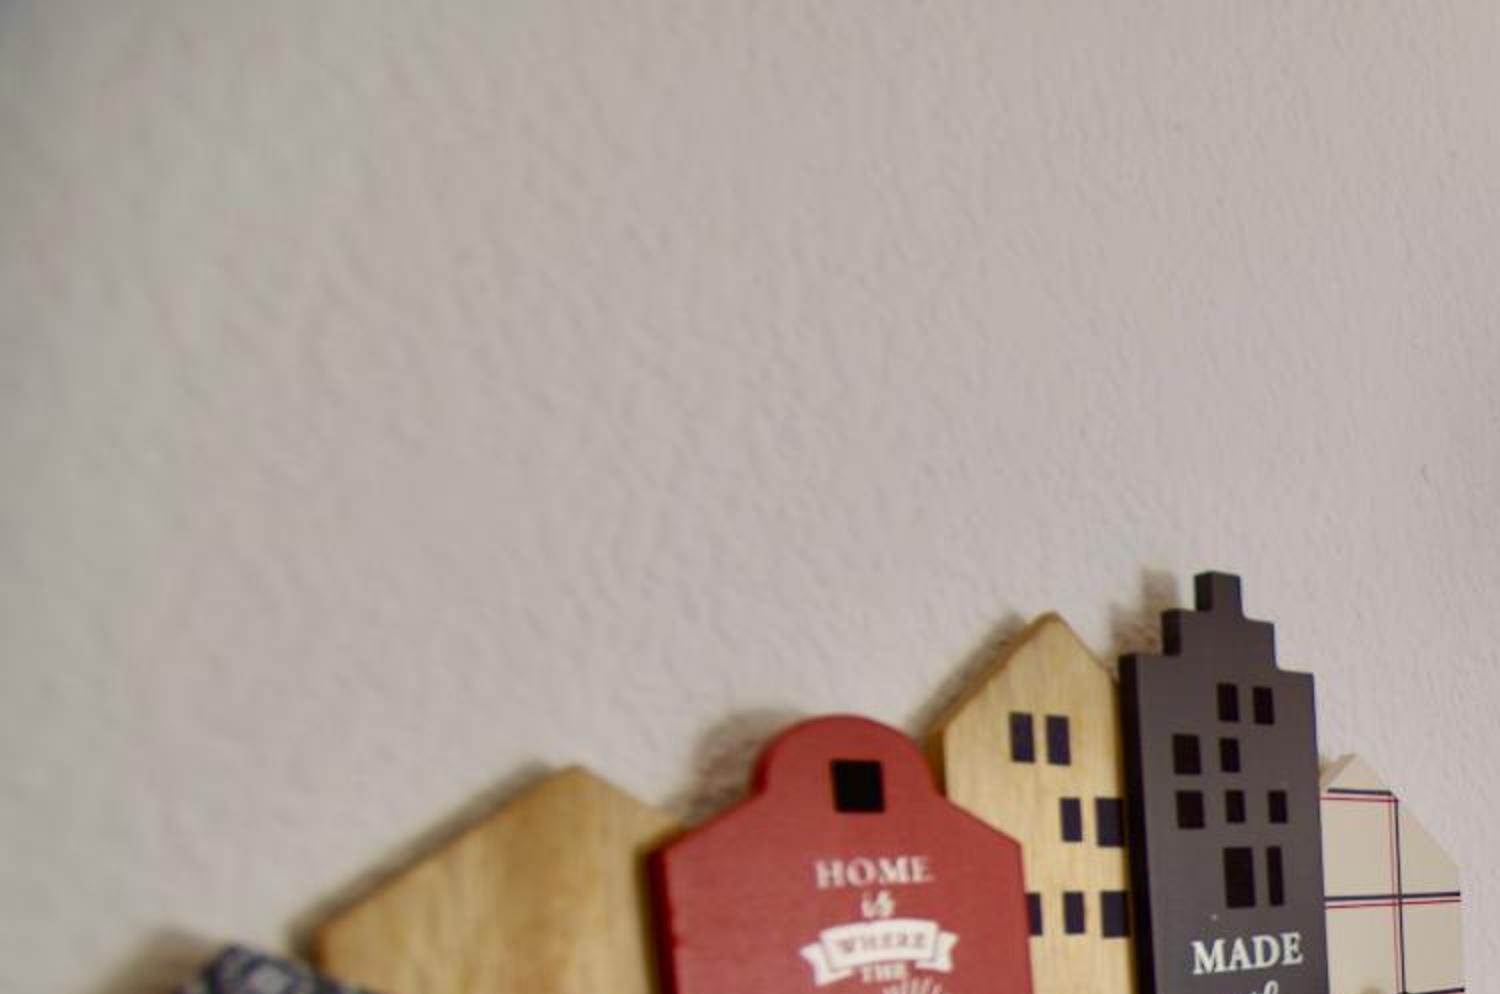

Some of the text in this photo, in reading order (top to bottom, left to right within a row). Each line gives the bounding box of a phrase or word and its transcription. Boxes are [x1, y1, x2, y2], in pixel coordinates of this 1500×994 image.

[814, 856, 935, 889] HOME
[835, 931, 927, 954] WHERE
[1190, 931, 1304, 976] MADE
